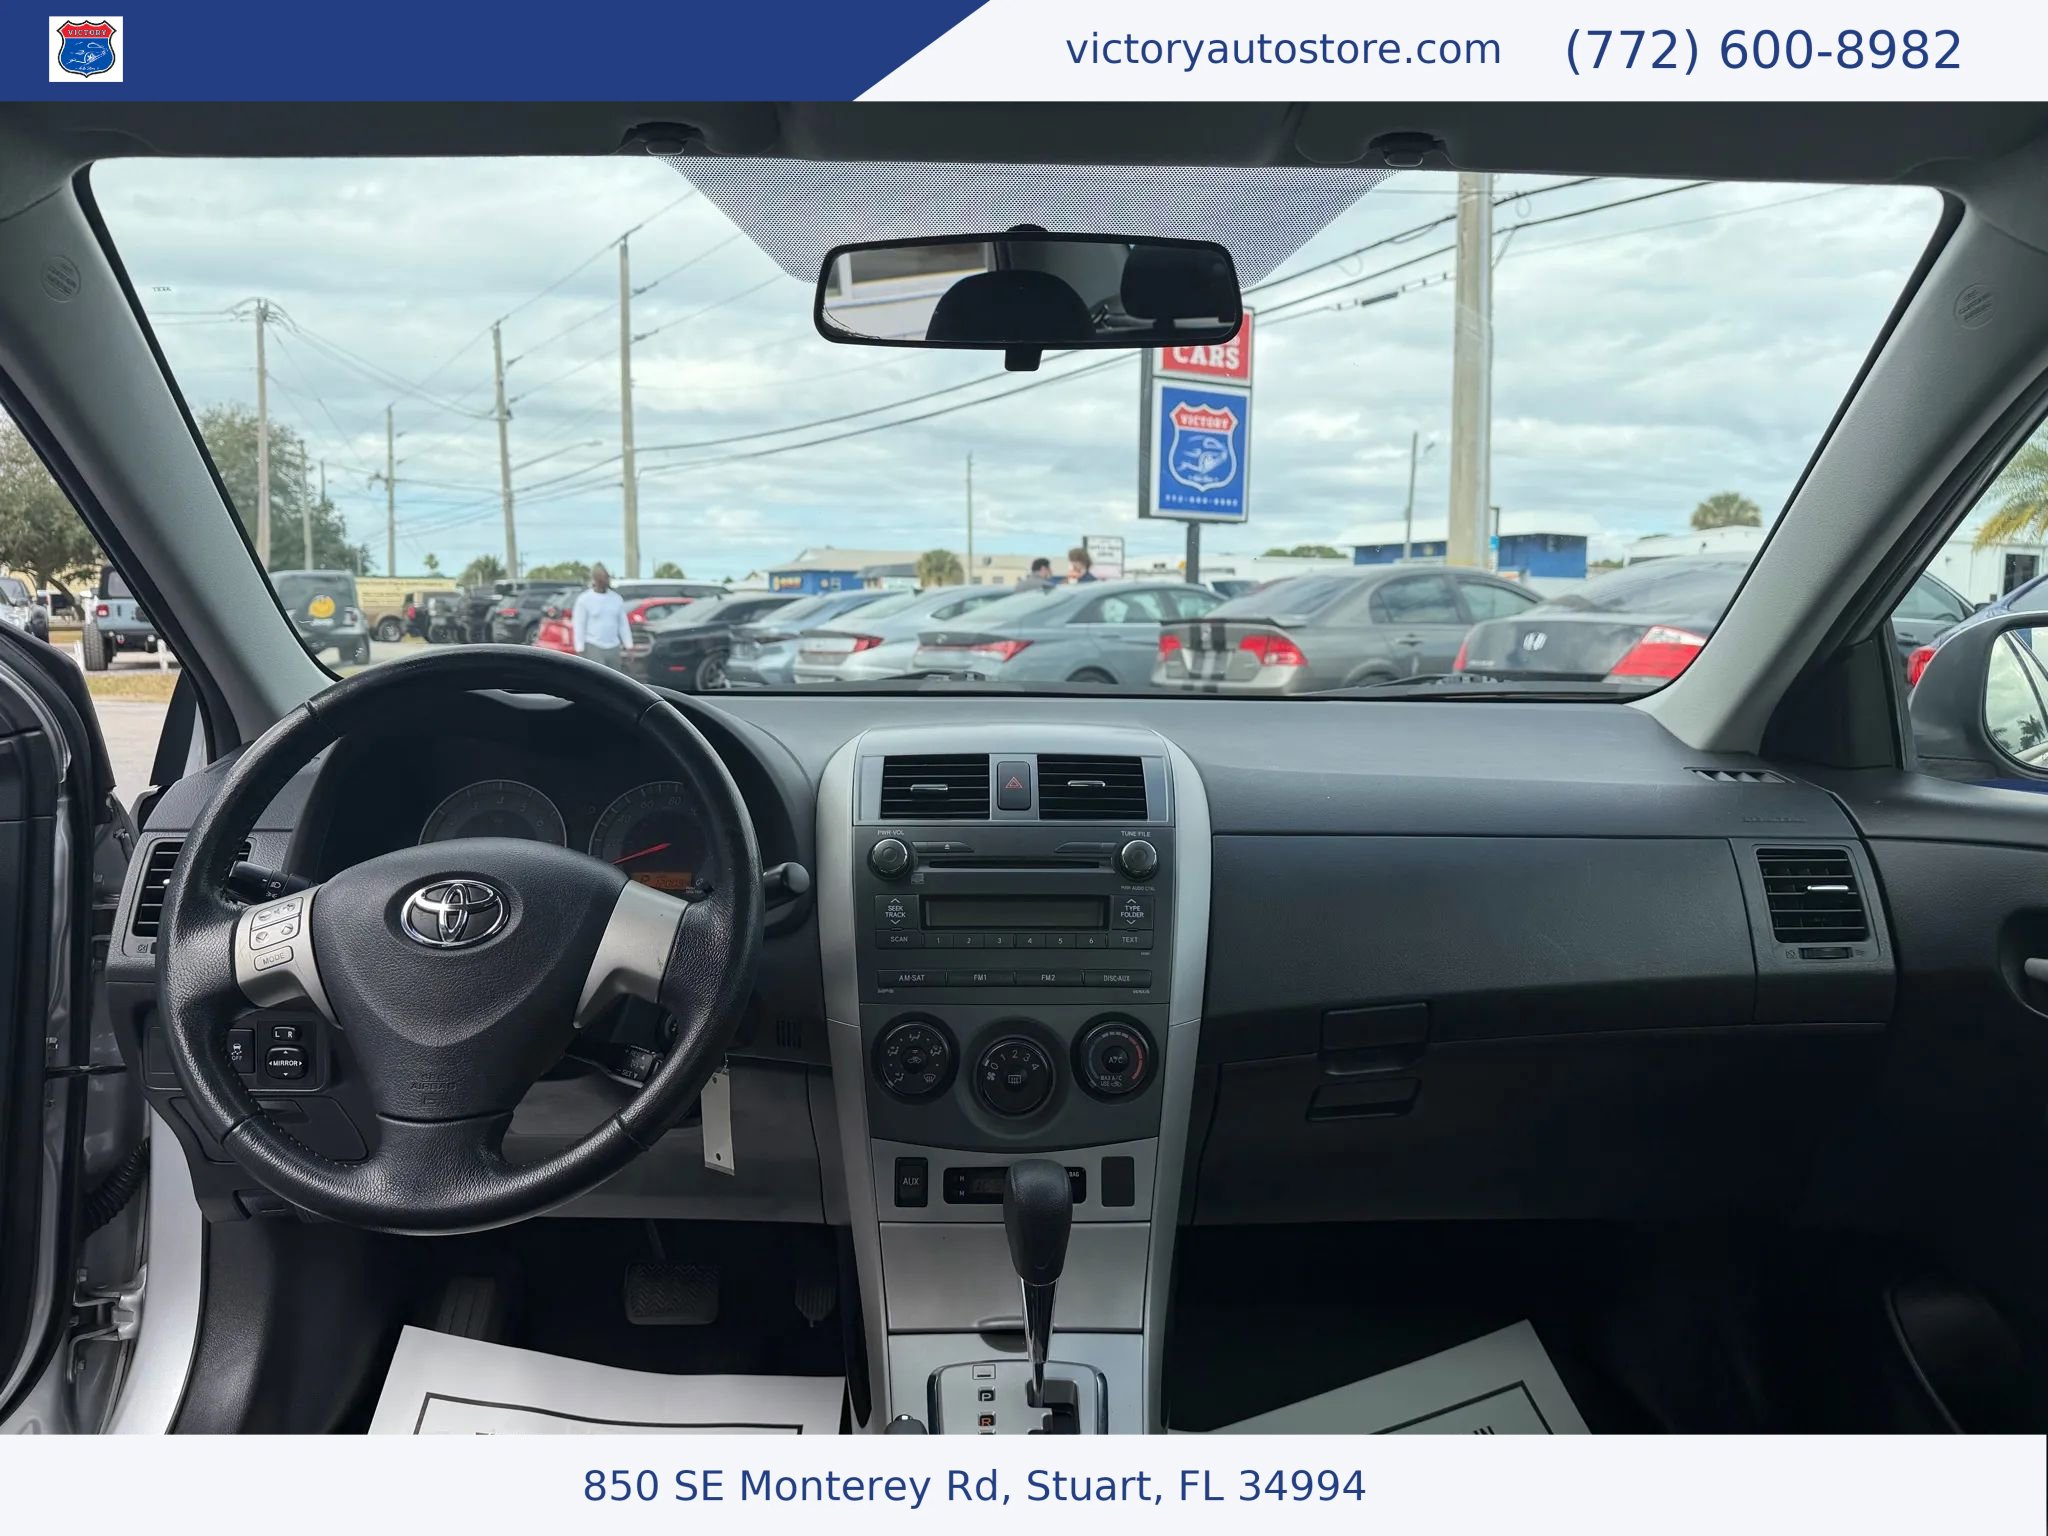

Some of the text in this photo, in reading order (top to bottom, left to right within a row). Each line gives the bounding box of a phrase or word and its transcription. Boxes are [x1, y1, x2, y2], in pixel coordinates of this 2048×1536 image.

[1172, 345, 1240, 371] CARS
[1180, 413, 1229, 430] VICTORY
[890, 935, 908, 943] SCAN
[1122, 936, 1138, 944] TEXT
[262, 953, 285, 965] MODE
[287, 1031, 294, 1039] R
[1012, 1049, 1018, 1059] 2
[1023, 1053, 1031, 1062] 3
[1031, 1063, 1040, 1071] 4
[902, 1176, 920, 1186] AUX
[981, 1392, 992, 1402] P
[980, 1417, 991, 1427] R
